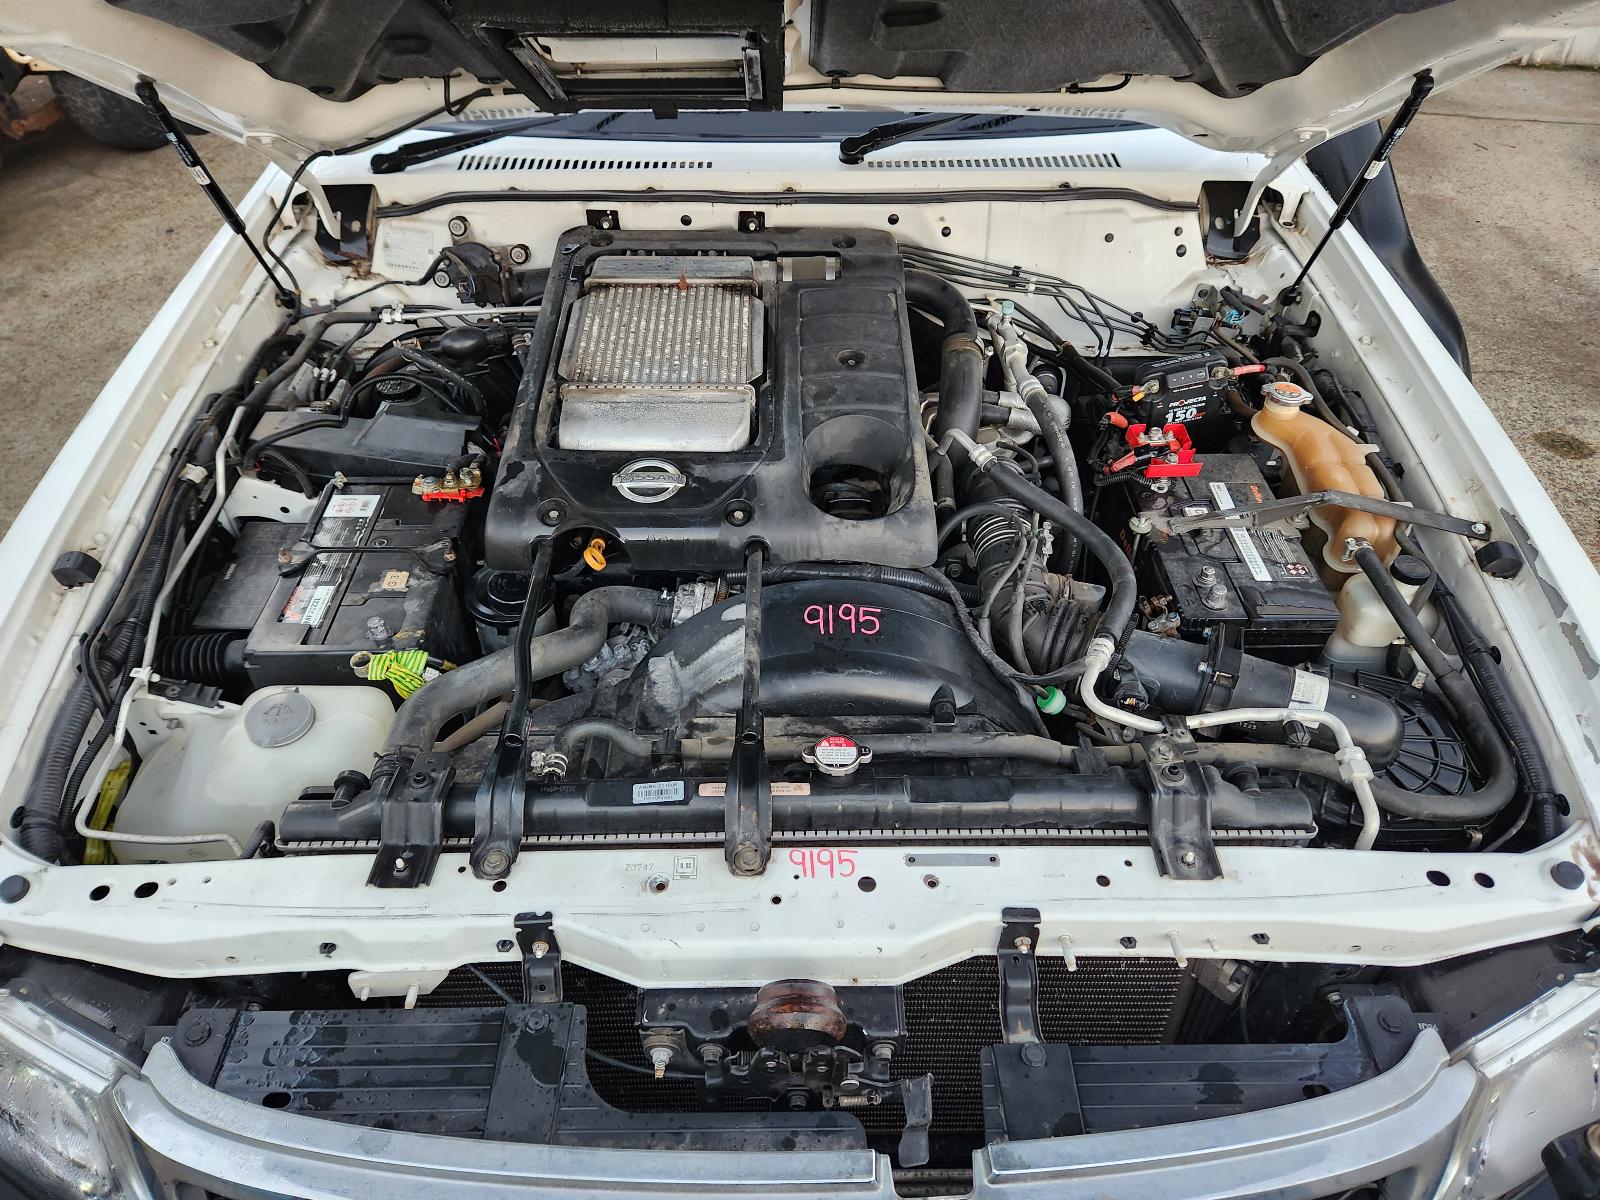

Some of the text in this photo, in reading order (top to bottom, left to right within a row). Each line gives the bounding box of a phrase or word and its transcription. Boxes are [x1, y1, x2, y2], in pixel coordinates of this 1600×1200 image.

[1168, 396, 1207, 408] PROJECTA
[1165, 407, 1198, 424] 150
[619, 473, 685, 484] NISSAN
[803, 603, 881, 635] 9195
[789, 848, 858, 878] 9195
